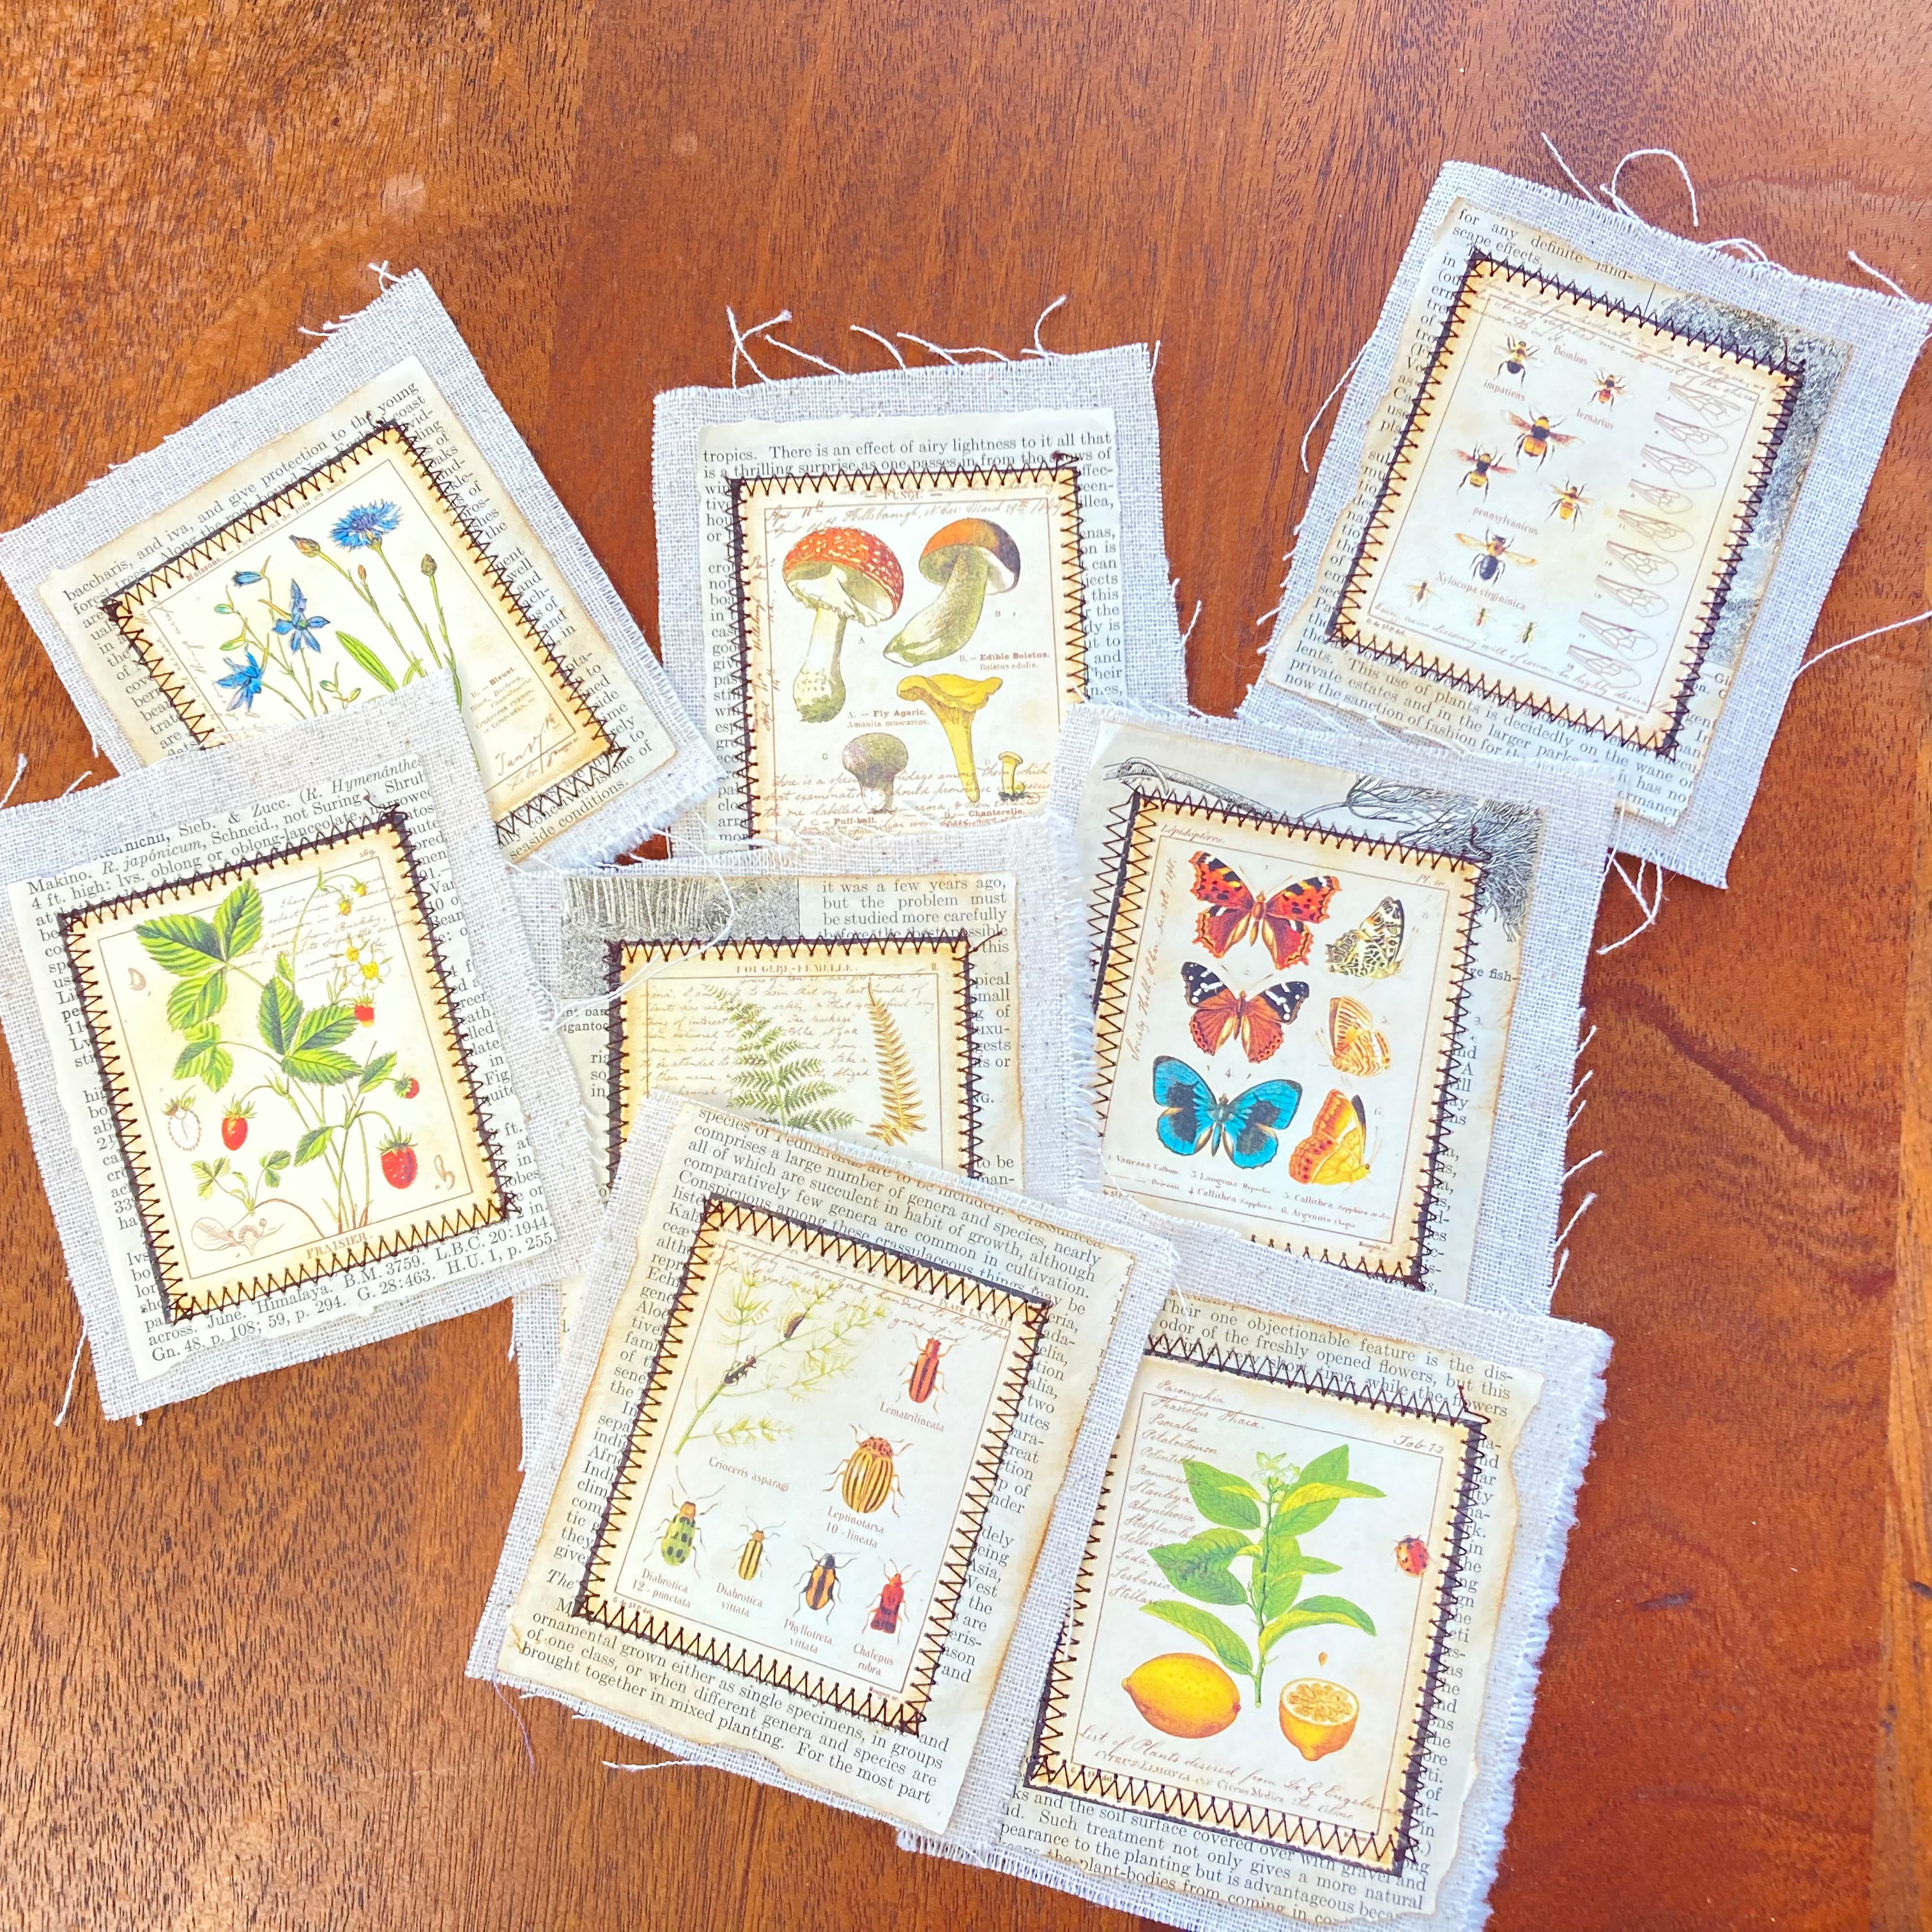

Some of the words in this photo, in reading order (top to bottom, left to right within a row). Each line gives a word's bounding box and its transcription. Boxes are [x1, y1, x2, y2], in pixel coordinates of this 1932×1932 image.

[1452, 227, 1491, 247] scape
[1458, 209, 1480, 225] for
[1492, 225, 1519, 241] any
[703, 450, 756, 464] tropics.
[769, 447, 812, 459] There
[818, 444, 828, 457] is
[833, 445, 850, 456] an
[856, 441, 894, 455] effect
[901, 441, 913, 452] of
[919, 440, 947, 455] airy
[953, 438, 1016, 452] lightness
[1022, 436, 1036, 447] to
[1041, 434, 1052, 447] it
[1058, 433, 1074, 446] all
[1081, 431, 1111, 444] that
[704, 468, 715, 478] is
[63, 561, 134, 602] baccharis,
[137, 537, 163, 560] and
[165, 524, 194, 542] iva,
[197, 501, 224, 523] and
[229, 482, 257, 507] give
[260, 441, 328, 487] protection
[331, 429, 346, 441] to
[485, 521, 507, 540] the
[1092, 560, 1117, 569] can
[549, 597, 559, 615] of
[1092, 589, 1119, 600] this
[1097, 604, 1119, 616] the
[562, 625, 576, 639] in
[588, 663, 601, 677] to
[873, 710, 889, 719] Fly
[1285, 673, 1314, 689] now
[1319, 683, 1341, 700] the
[1344, 693, 1403, 721] sanction
[1425, 719, 1476, 747] fashion
[1290, 659, 1342, 683] private
[1349, 678, 1399, 702] estates
[1404, 698, 1432, 713] and
[1459, 714, 1482, 732] the
[1488, 724, 1531, 750] larger
[1348, 658, 1379, 678] This
[1386, 675, 1409, 689] use
[1415, 684, 1431, 695] of
[1435, 693, 1480, 714] plants
[1485, 708, 1498, 719] is
[1503, 713, 1575, 747] decidedly
[1605, 749, 1629, 767] the
[639, 741, 654, 758] of
[252, 801, 290, 818] Zucc.
[558, 781, 629, 827] conditions.
[27, 871, 91, 895] Makino.
[102, 862, 118, 875] R.
[282, 807, 308, 825] not
[31, 898, 41, 910] 4
[46, 891, 66, 907] ft.
[119, 872, 146, 887] lvs.
[151, 856, 203, 882] oblong
[208, 850, 223, 862] or
[823, 882, 833, 893] it
[841, 883, 868, 893] was
[894, 880, 919, 892] few
[930, 880, 967, 893] years
[976, 879, 1006, 891] ago,
[823, 897, 848, 908] but
[861, 896, 884, 908] the
[898, 894, 958, 910] problem
[971, 894, 1007, 904] must
[824, 913, 839, 925] be
[845, 912, 898, 924] studied
[902, 912, 939, 923] more
[944, 908, 1007, 923] carefully
[694, 1124, 766, 1156] comprises
[784, 1153, 822, 1175] large
[826, 1167, 883, 1192] number
[908, 1194, 956, 1216] genera
[993, 1222, 1046, 1248] species,
[1054, 1243, 1101, 1266] nearly
[684, 1156, 791, 1200] comparatively
[829, 1202, 877, 1227] genera
[915, 1232, 977, 1259] common
[1006, 1261, 1089, 1298] cultivation.
[734, 1153, 776, 1176] which
[809, 1179, 880, 1209] succulent
[905, 1206, 942, 1229] habit
[967, 1232, 1022, 1261] growth,
[1030, 1252, 1095, 1282] although
[148, 1326, 197, 1346] across.
[208, 1311, 246, 1328] June.
[257, 1287, 333, 1314] Himalaya.
[385, 1255, 425, 1276] 3759.
[435, 1236, 485, 1261] L.B.C.
[489, 1215, 553, 1245] 20:1944.
[152, 1347, 180, 1361] Gn.
[231, 1321, 262, 1339] 108;
[269, 1312, 290, 1328] 59,
[295, 1311, 309, 1324] p.
[316, 1296, 346, 1314] 294.
[357, 1287, 376, 1300] G.
[526, 1232, 556, 1251] 255.
[1160, 1318, 1194, 1334] odor
[1256, 1335, 1309, 1360] freshly
[1317, 1351, 1370, 1370] opened
[1378, 1360, 1436, 1386] flowers,
[1482, 1383, 1510, 1400] this
[1211, 1312, 1238, 1325] one
[1248, 1317, 1349, 1348] objectionable
[1360, 1338, 1415, 1361] feature
[1449, 1355, 1473, 1374] the
[641, 1567, 688, 1593] Diabrotica
[716, 1582, 763, 1608] Diabrotica
[858, 1661, 881, 1675] rubra
[532, 1613, 617, 1648] ornamental
[620, 1644, 666, 1666] grown
[671, 1659, 715, 1684] either
[739, 1686, 782, 1710] single
[786, 1703, 865, 1744] specimens,
[891, 1741, 943, 1769] groups
[585, 1665, 647, 1696] together
[669, 1696, 715, 1722] mixed
[719, 1715, 784, 1749] planting.
[581, 1648, 618, 1671] class,
[694, 1687, 757, 1720] different
[762, 1713, 812, 1740] genera
[853, 1746, 905, 1776] species
[1087, 1820, 1165, 1850] treatment
[1250, 1860, 1290, 1880] gives
[1317, 1878, 1356, 1895] more
[1364, 1887, 1423, 1910] natural
[1124, 1851, 1190, 1877] planting
[1244, 1876, 1354, 1915] advantageous
